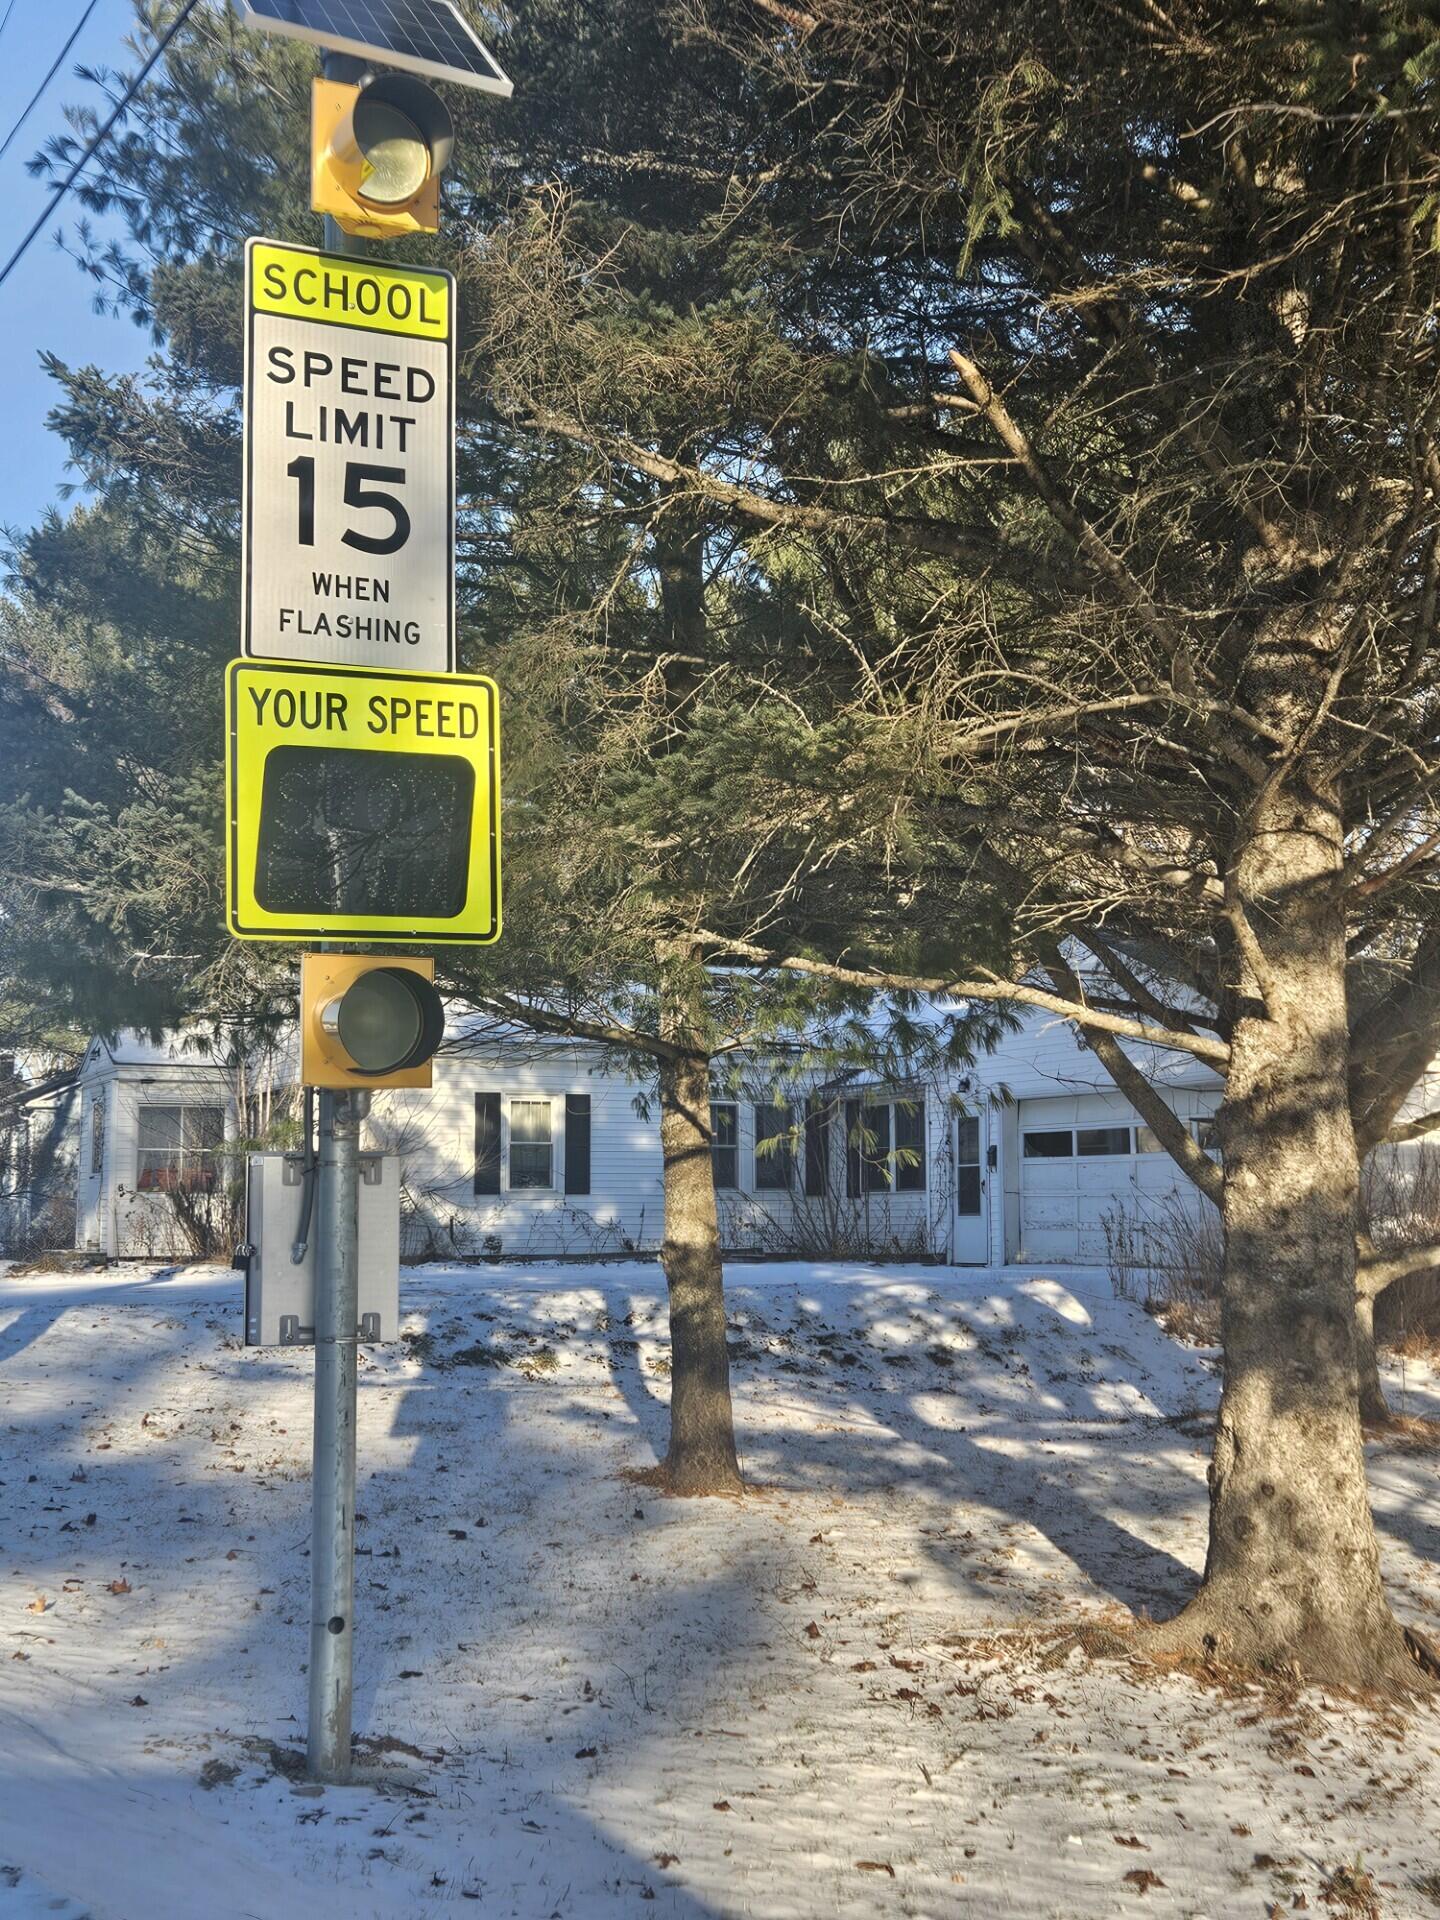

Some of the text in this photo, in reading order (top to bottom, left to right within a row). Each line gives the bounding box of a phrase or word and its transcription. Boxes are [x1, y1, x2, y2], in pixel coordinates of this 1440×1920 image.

[263, 263, 440, 325] SCHOOL
[266, 346, 435, 403] SPEED
[286, 401, 415, 452] LIMIT
[287, 455, 411, 556] 15
[312, 572, 390, 603] WHEN
[279, 608, 421, 645] FLASHING
[248, 687, 478, 739] YOUR SPEED
